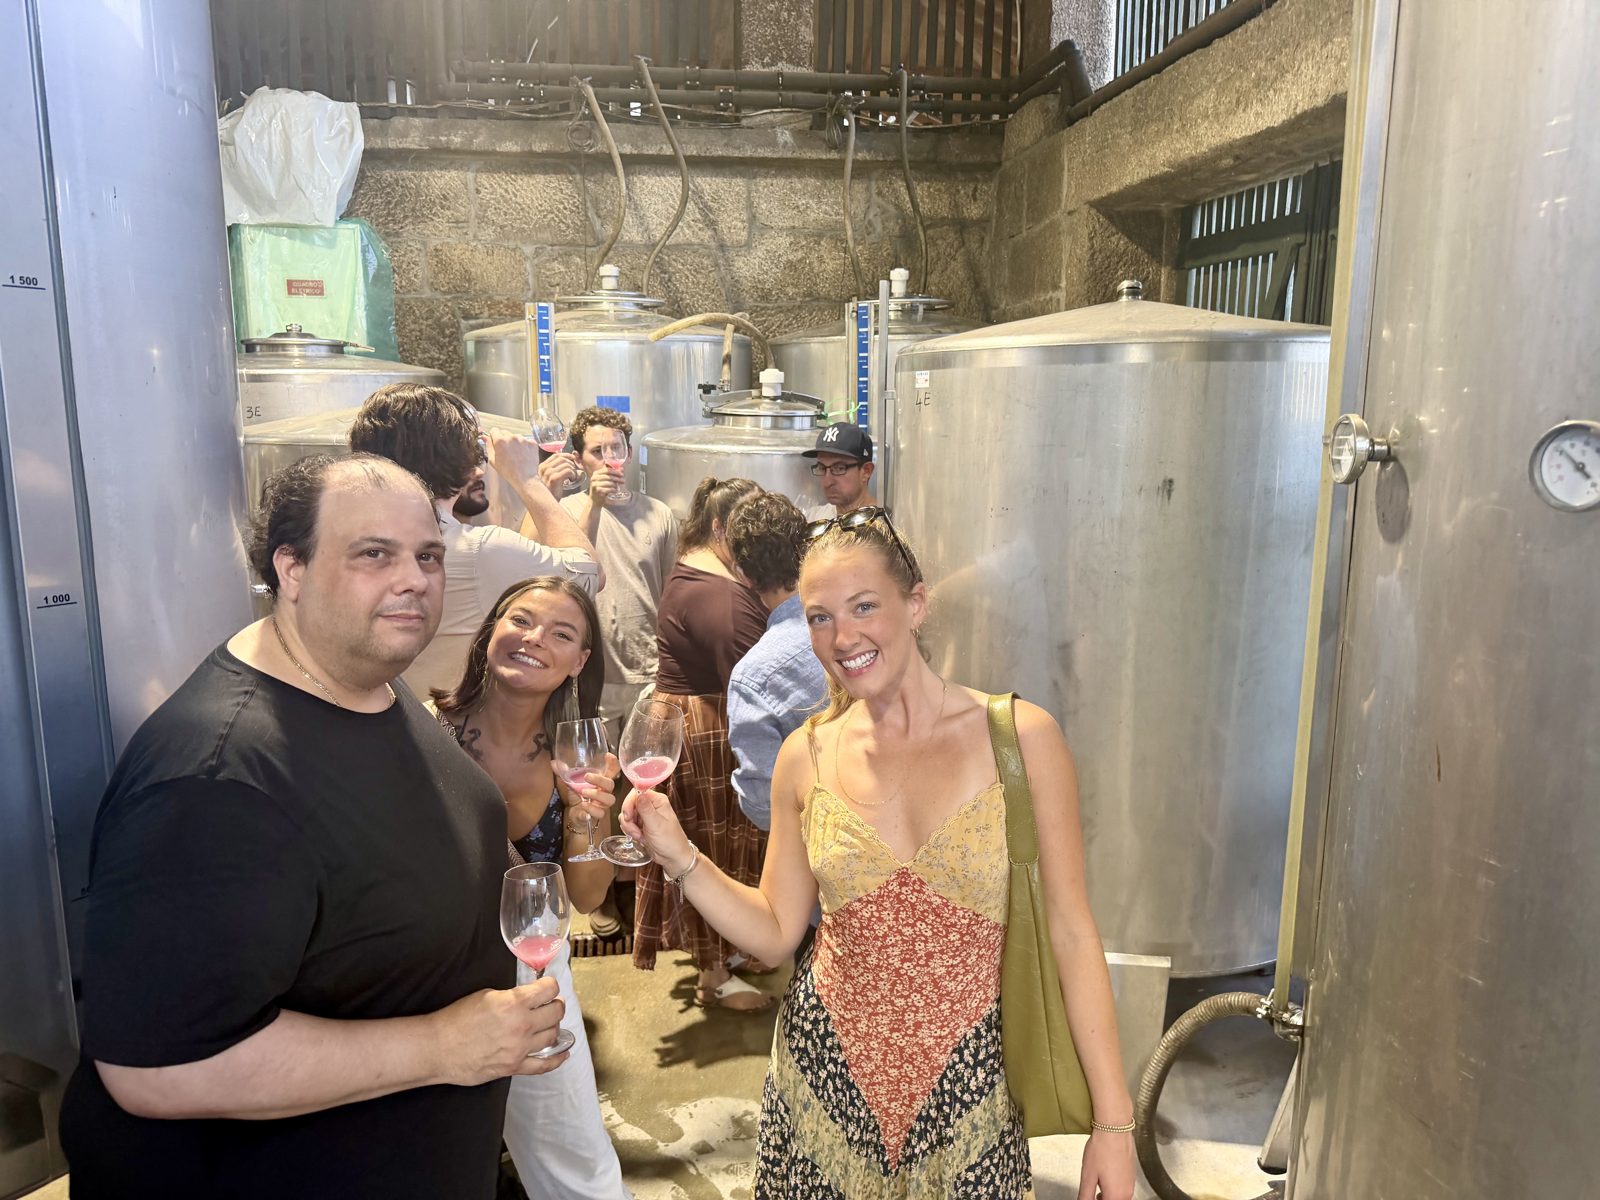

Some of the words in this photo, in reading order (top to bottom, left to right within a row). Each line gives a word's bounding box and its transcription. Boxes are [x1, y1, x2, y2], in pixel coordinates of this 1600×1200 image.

[9, 275, 15, 284] 1
[19, 276, 38, 286] 500
[246, 406, 261, 418] 3E
[823, 427, 839, 442] NY
[43, 595, 49, 605] 1
[52, 593, 70, 603] 000
